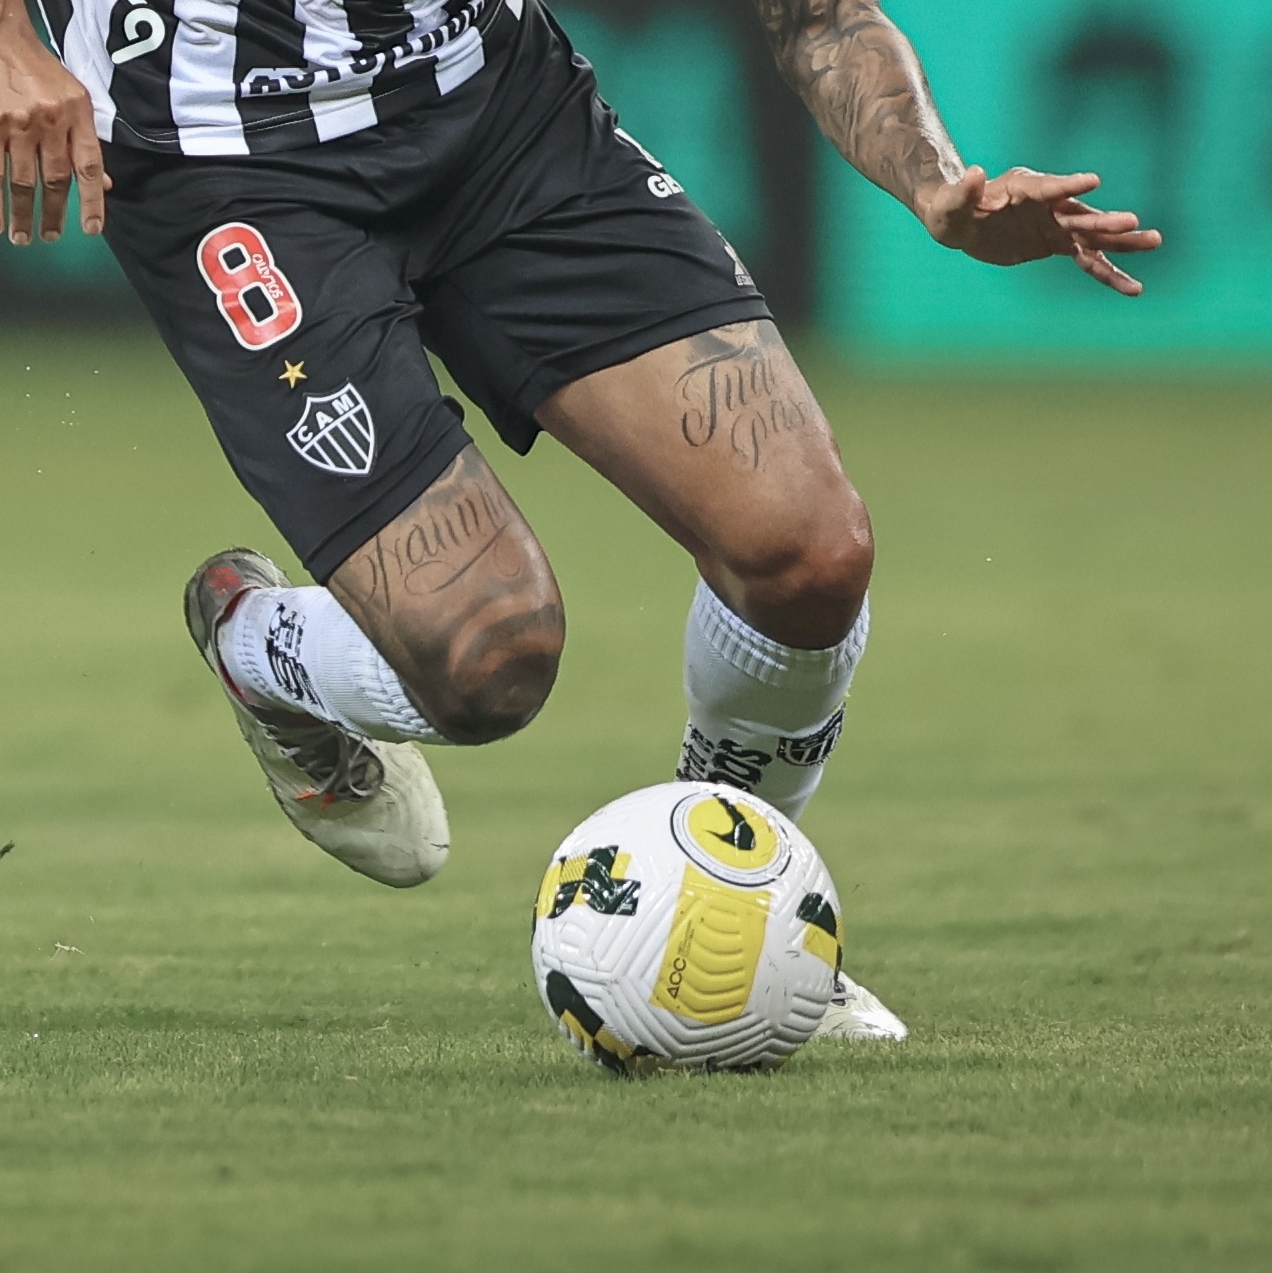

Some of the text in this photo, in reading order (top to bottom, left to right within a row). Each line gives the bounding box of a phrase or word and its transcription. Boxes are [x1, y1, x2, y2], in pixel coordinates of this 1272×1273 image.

[196, 221, 304, 352] 8
[251, 252, 285, 300] SOLATIO
[297, 392, 355, 444] CAM
[665, 957, 687, 1000] ACC
